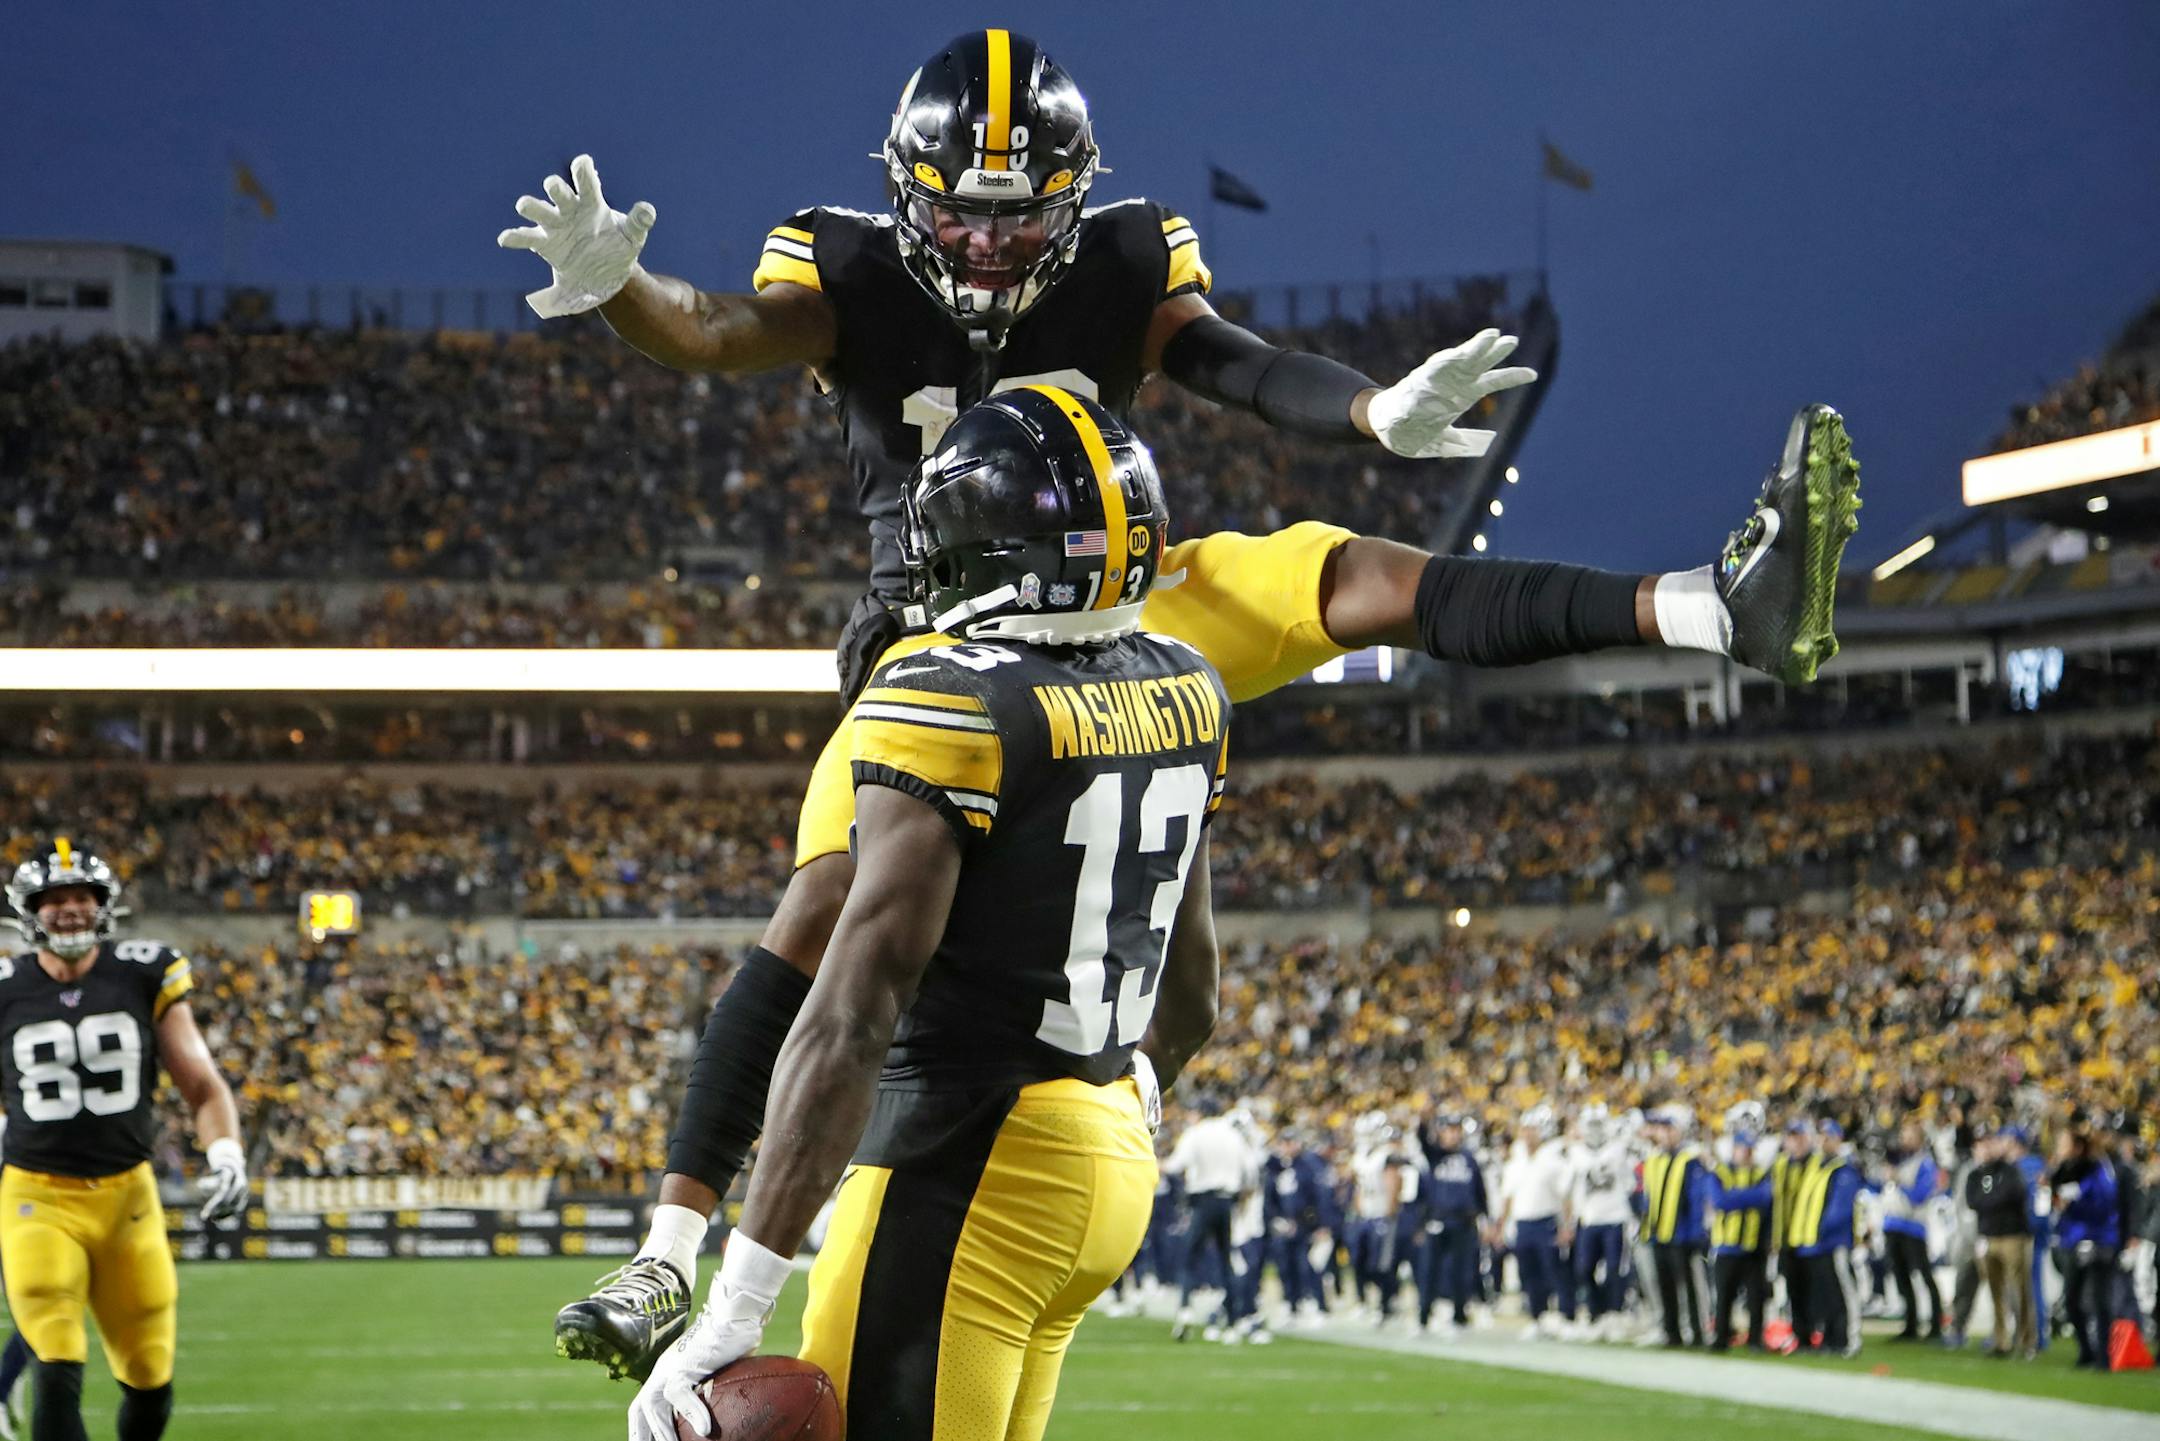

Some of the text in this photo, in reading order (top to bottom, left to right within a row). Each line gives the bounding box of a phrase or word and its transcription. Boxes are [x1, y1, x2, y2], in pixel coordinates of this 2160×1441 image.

[976, 172, 1014, 188] Steelers
[1131, 530, 1147, 551] DD
[1082, 564, 1145, 611] 13
[1035, 764, 1209, 1056] 13
[13, 1012, 141, 1121] 89
